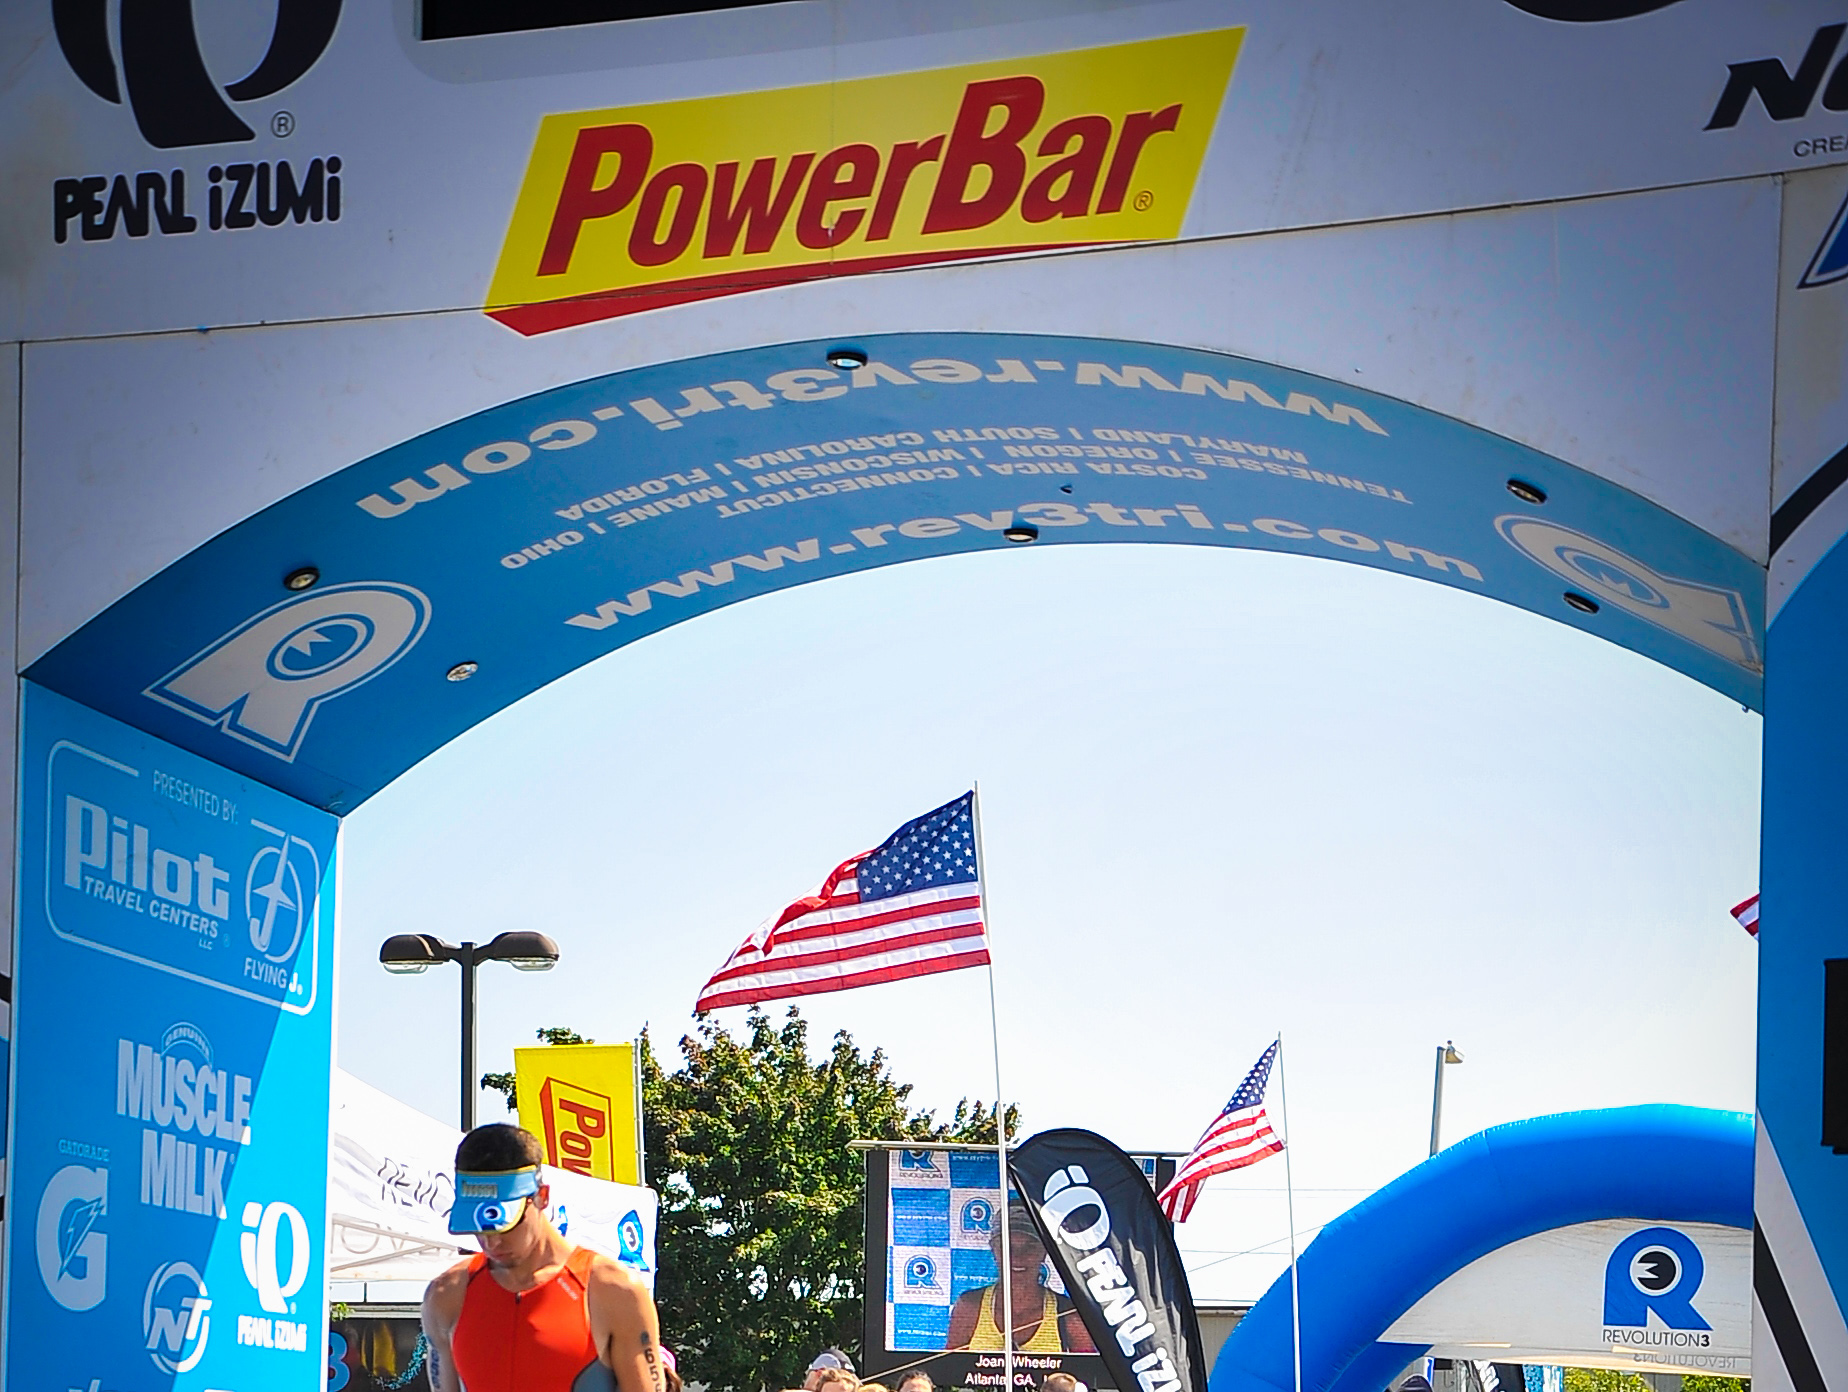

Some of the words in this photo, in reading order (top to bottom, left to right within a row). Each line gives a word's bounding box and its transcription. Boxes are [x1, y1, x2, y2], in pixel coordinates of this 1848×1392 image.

[1702, 22, 1848, 132] N
[1794, 136, 1848, 158] CRE
[536, 75, 1183, 277] PowerBar
[53, 168, 197, 244] PEARL
[734, 432, 921, 472] CAROLINA
[933, 427, 1060, 444] SOUTH
[1004, 443, 1159, 463] OREGON
[1093, 428, 1310, 465] MARYLAND
[756, 447, 964, 490] WISCONSIN
[988, 461, 1079, 476] RICA
[1096, 463, 1207, 480] COSTA
[1194, 451, 1414, 505] TENNESSEE
[555, 464, 712, 521] FLORIDA
[611, 483, 730, 528] MAINE
[717, 462, 960, 520] CONNECTICUT
[499, 529, 584, 570] OHIO
[153, 769, 221, 817] PRESENTED
[222, 799, 239, 825] BY:
[64, 795, 229, 921] Pilot
[85, 876, 144, 914] TRAVEL
[149, 900, 218, 938] CENTERS
[244, 957, 287, 989] FLYING
[116, 1038, 251, 1145] MUSCLE
[58, 1139, 110, 1162] GATORADE
[141, 1128, 227, 1219] MILK
[1603, 1329, 1710, 1348] REVOLUTION3
[965, 1373, 1008, 1386] Atlanta
[975, 1355, 1005, 1368] Joan
[1012, 1356, 1062, 1369] Wheeler
